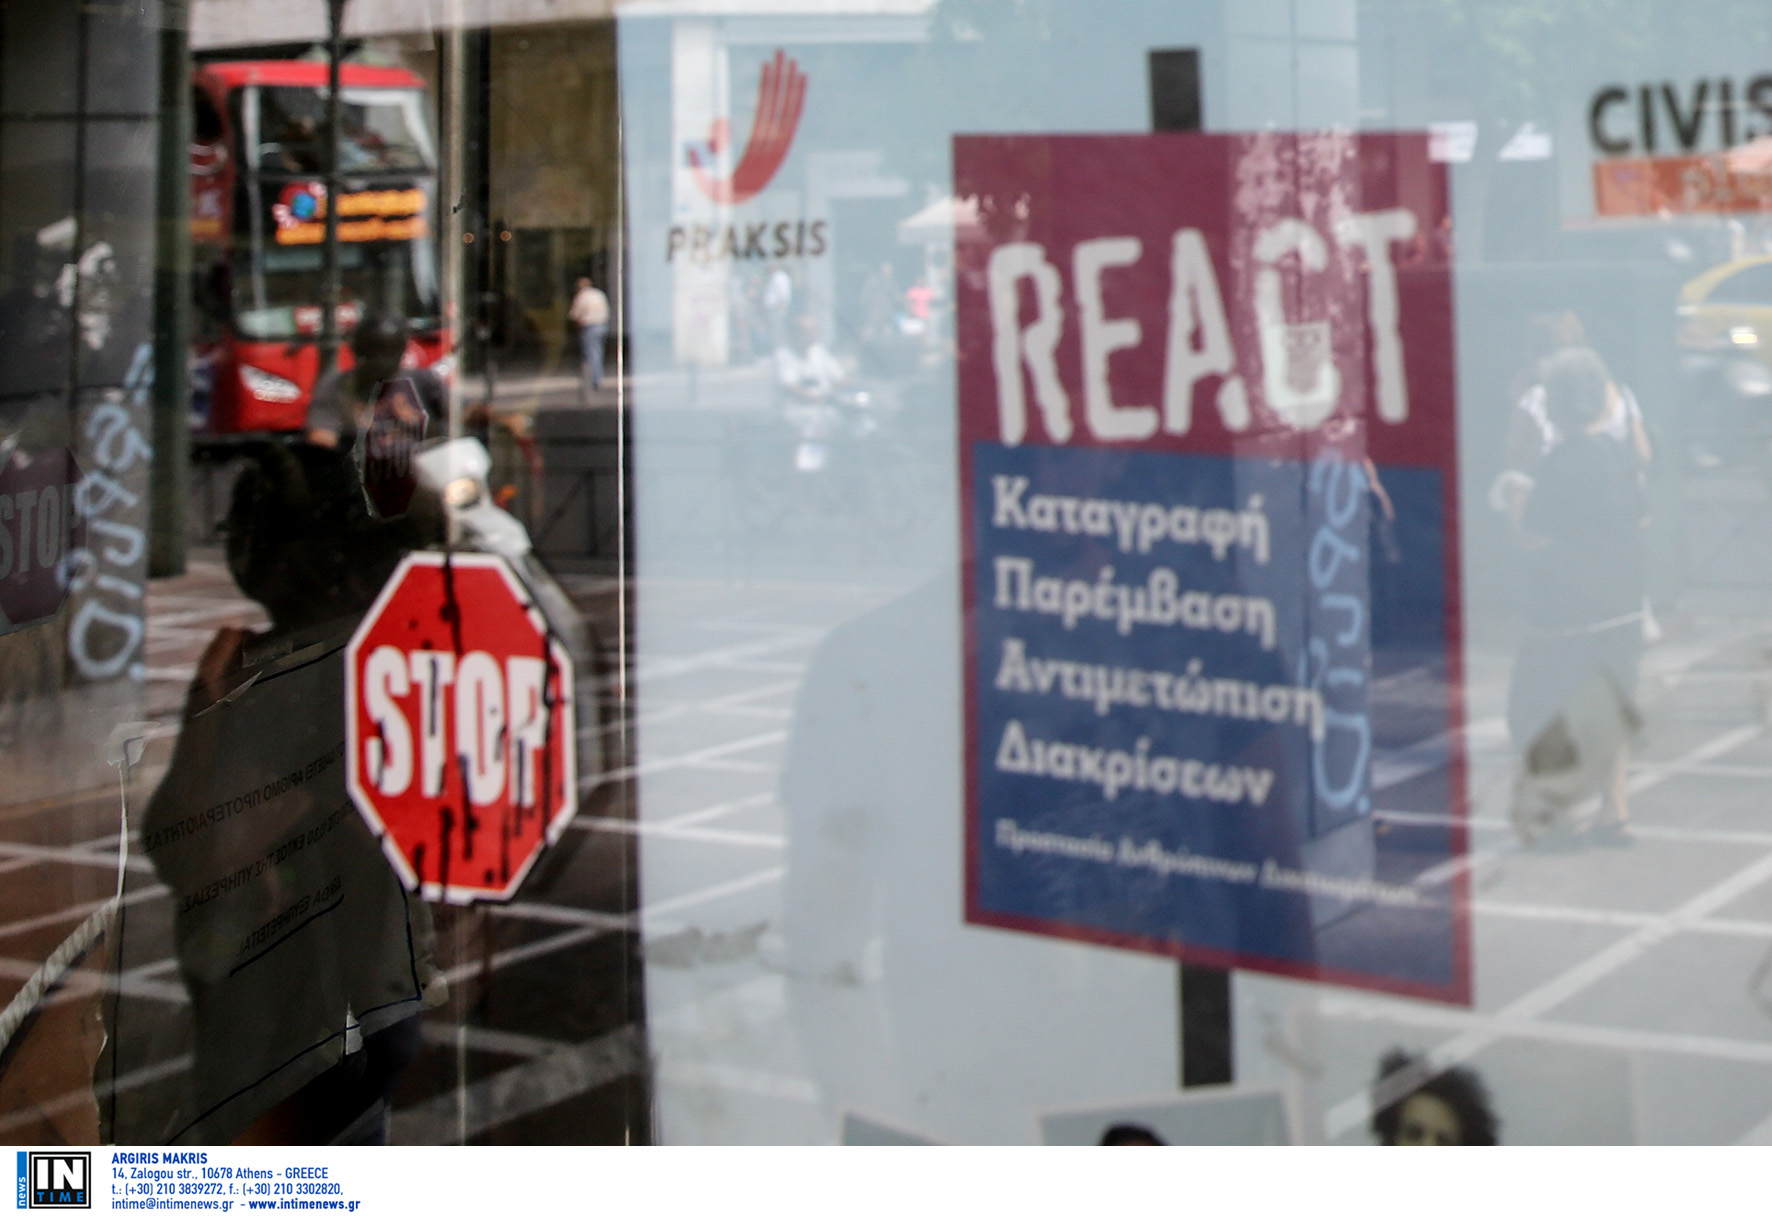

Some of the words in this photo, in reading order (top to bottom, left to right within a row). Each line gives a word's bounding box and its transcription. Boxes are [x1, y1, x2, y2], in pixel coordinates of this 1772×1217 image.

[666, 219, 828, 264] PRAKSIS
[986, 207, 1420, 449] REACT
[992, 474, 1271, 564] Καταγραφή
[993, 555, 1277, 651] Παρέμβαση
[363, 644, 549, 807] STOP
[995, 638, 1328, 743] Αντιμετώπιση
[995, 718, 1276, 807] Διακρίσεων
